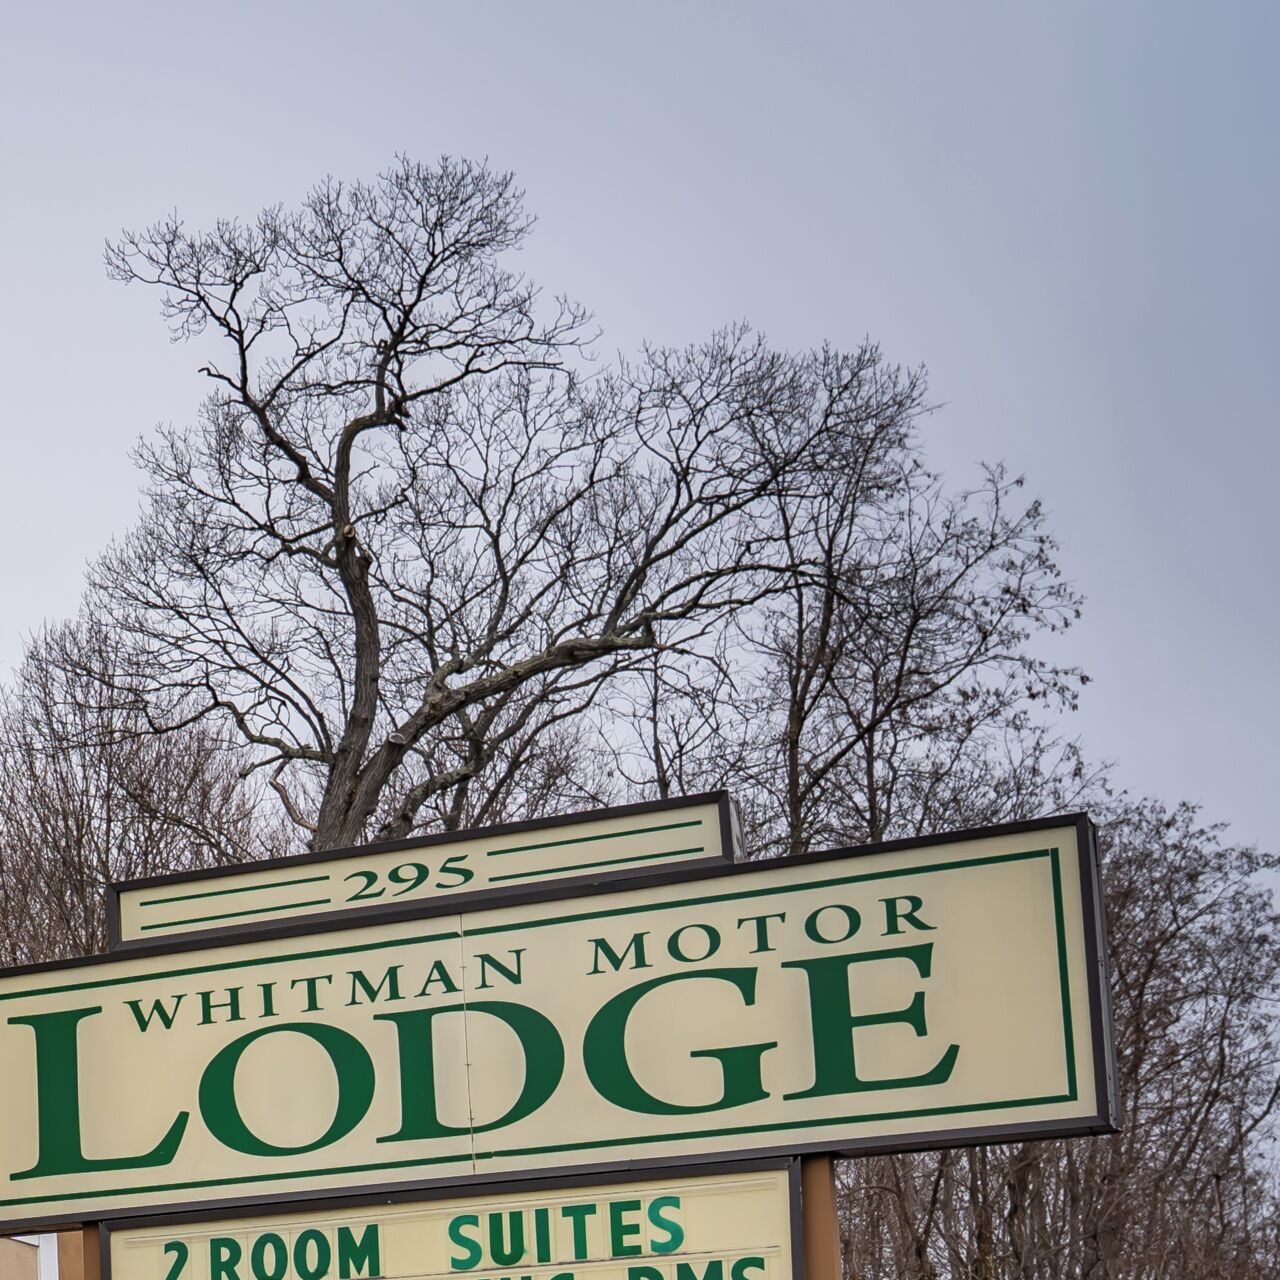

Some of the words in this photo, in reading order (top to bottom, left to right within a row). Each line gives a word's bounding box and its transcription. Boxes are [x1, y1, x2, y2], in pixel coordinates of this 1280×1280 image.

[344, 853, 476, 903] 295
[124, 948, 526, 1034] WHITMAN
[587, 893, 938, 977] MOTOR
[7, 941, 961, 1183] LODGE
[447, 1195, 686, 1273] SUITES
